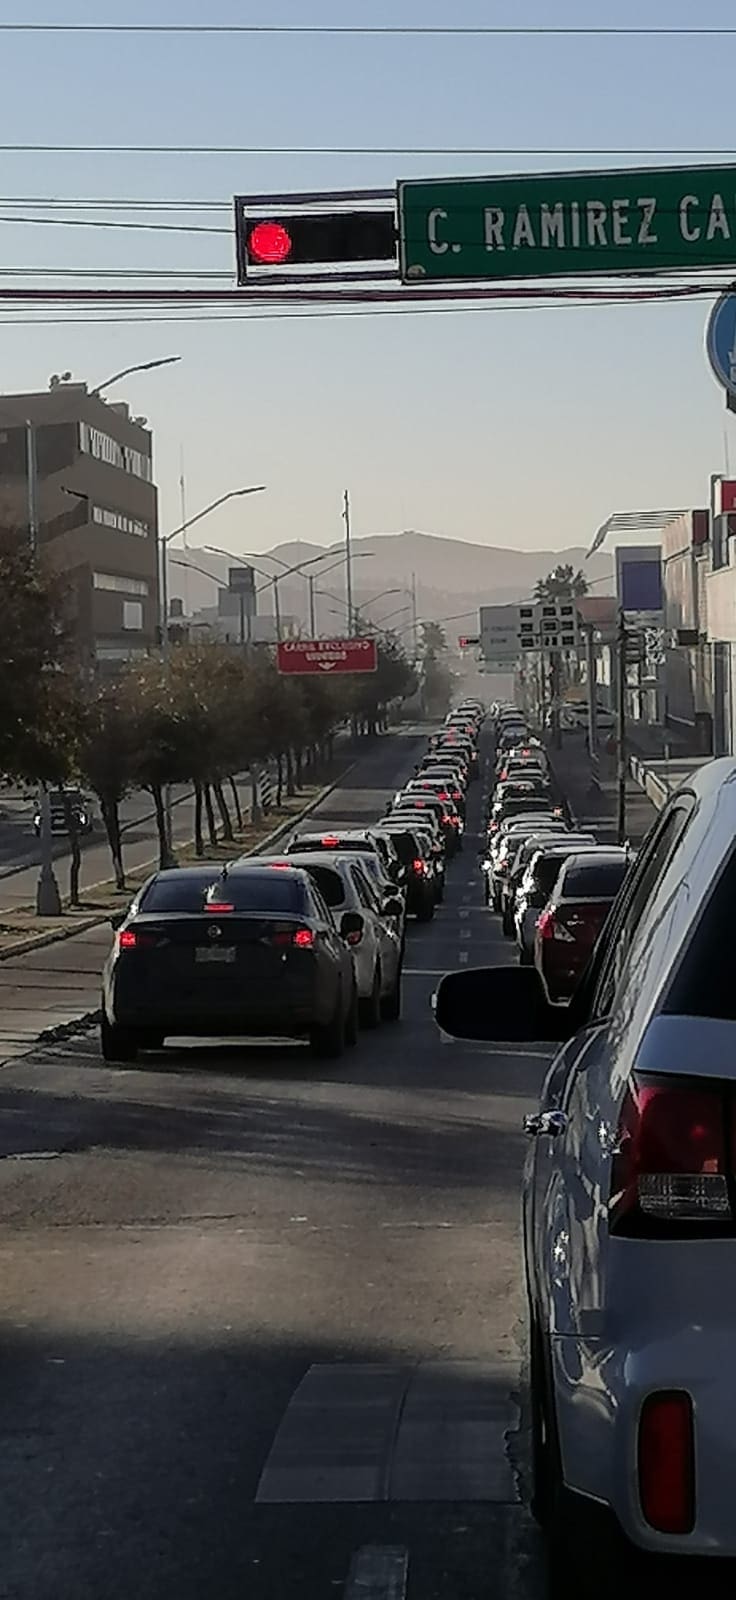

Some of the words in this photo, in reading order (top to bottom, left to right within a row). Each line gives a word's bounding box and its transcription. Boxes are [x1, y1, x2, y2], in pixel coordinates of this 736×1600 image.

[427, 207, 462, 254] C.
[483, 197, 658, 251] RAMIREZ
[679, 193, 736, 241] CA
